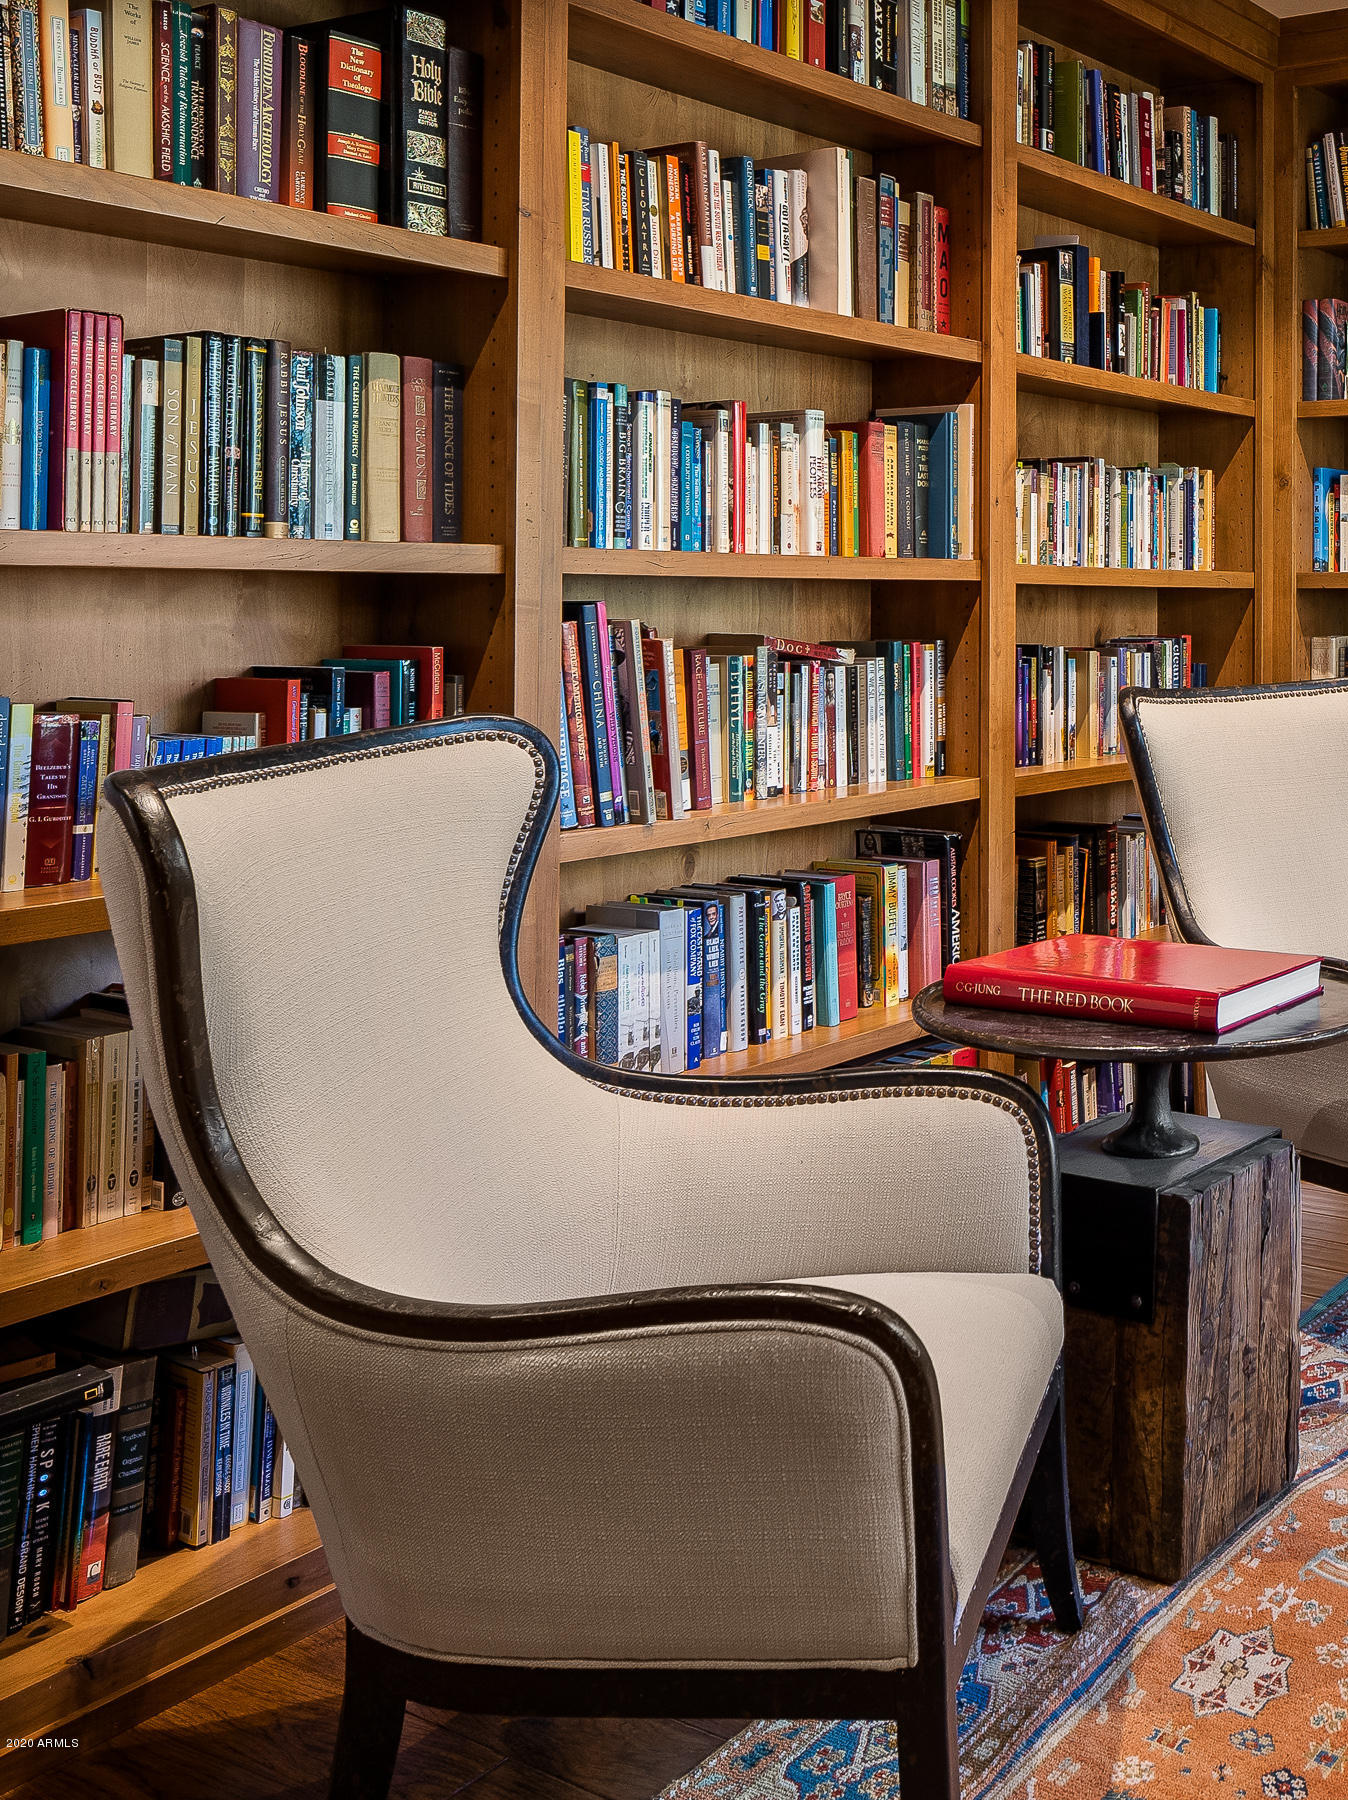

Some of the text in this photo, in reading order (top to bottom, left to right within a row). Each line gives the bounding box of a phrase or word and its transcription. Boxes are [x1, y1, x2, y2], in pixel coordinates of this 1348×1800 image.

[90, 27, 102, 94] BUDDHA or BUST
[161, 42, 170, 82] SCIENCE
[298, 44, 308, 95] BLOODLINE
[340, 61, 374, 78] Dictionary
[350, 56, 365, 66] New
[351, 47, 364, 57] The
[411, 55, 442, 85] Holy
[178, 31, 189, 165] Jewish Tales of Reincarnation
[342, 79, 373, 95] Theology
[353, 74, 361, 82] of
[411, 79, 442, 106] Bible
[161, 105, 170, 145] AKASHIC
[190, 80, 199, 160] TRANSCENDENCE
[261, 31, 276, 186] FORBIDDEN ARCHEOLOGY
[297, 114, 306, 137] HOLY
[418, 119, 439, 129] EDITION
[162, 147, 170, 172] FIELD
[297, 139, 306, 165] GRAIL
[412, 182, 444, 195] RIVERSIDE
[639, 169, 649, 261] CLEOPATRA
[70, 331, 79, 432] THE LIFE CYCLE LIBRARY
[84, 335, 93, 435] THE LIFE CYCLE LIBRARY
[110, 337, 118, 437] THE LIFE CYCLE LIBRARY
[146, 371, 154, 393] BORG
[226, 344, 236, 439] LAUGHING JESUS
[278, 352, 288, 446] RABBI JESUS
[294, 357, 309, 430] Paul Johnson
[352, 382, 360, 418] CELESTINE
[97, 402, 105, 436] LIBRARY
[166, 388, 179, 495] SON of MAN
[188, 399, 200, 494] JESUS
[415, 419, 425, 477] CREATION
[445, 387, 454, 516] THE PRINCE OF TIDES
[290, 459, 300, 508] Christianity
[299, 460, 311, 492] History
[618, 432, 626, 497] BIG BRAIN
[569, 647, 587, 761] GREAT AMERICAN WEST
[592, 680, 604, 728] CHINA
[696, 692, 705, 735] CULTURE
[730, 671, 741, 727] ETHYL
[758, 916, 766, 932] The
[888, 871, 898, 937] JIMMY BUFFETT
[757, 993, 766, 1014] Gray
[1018, 987, 1135, 1014] THE RED BOOK
[48, 1102, 56, 1144] TEACHING
[48, 1148, 55, 1158] OF
[47, 1163, 55, 1195] BUDDHA
[219, 1384, 232, 1448] WRINKLES IN TIME
[92, 1432, 112, 1492] RARE EARTH
